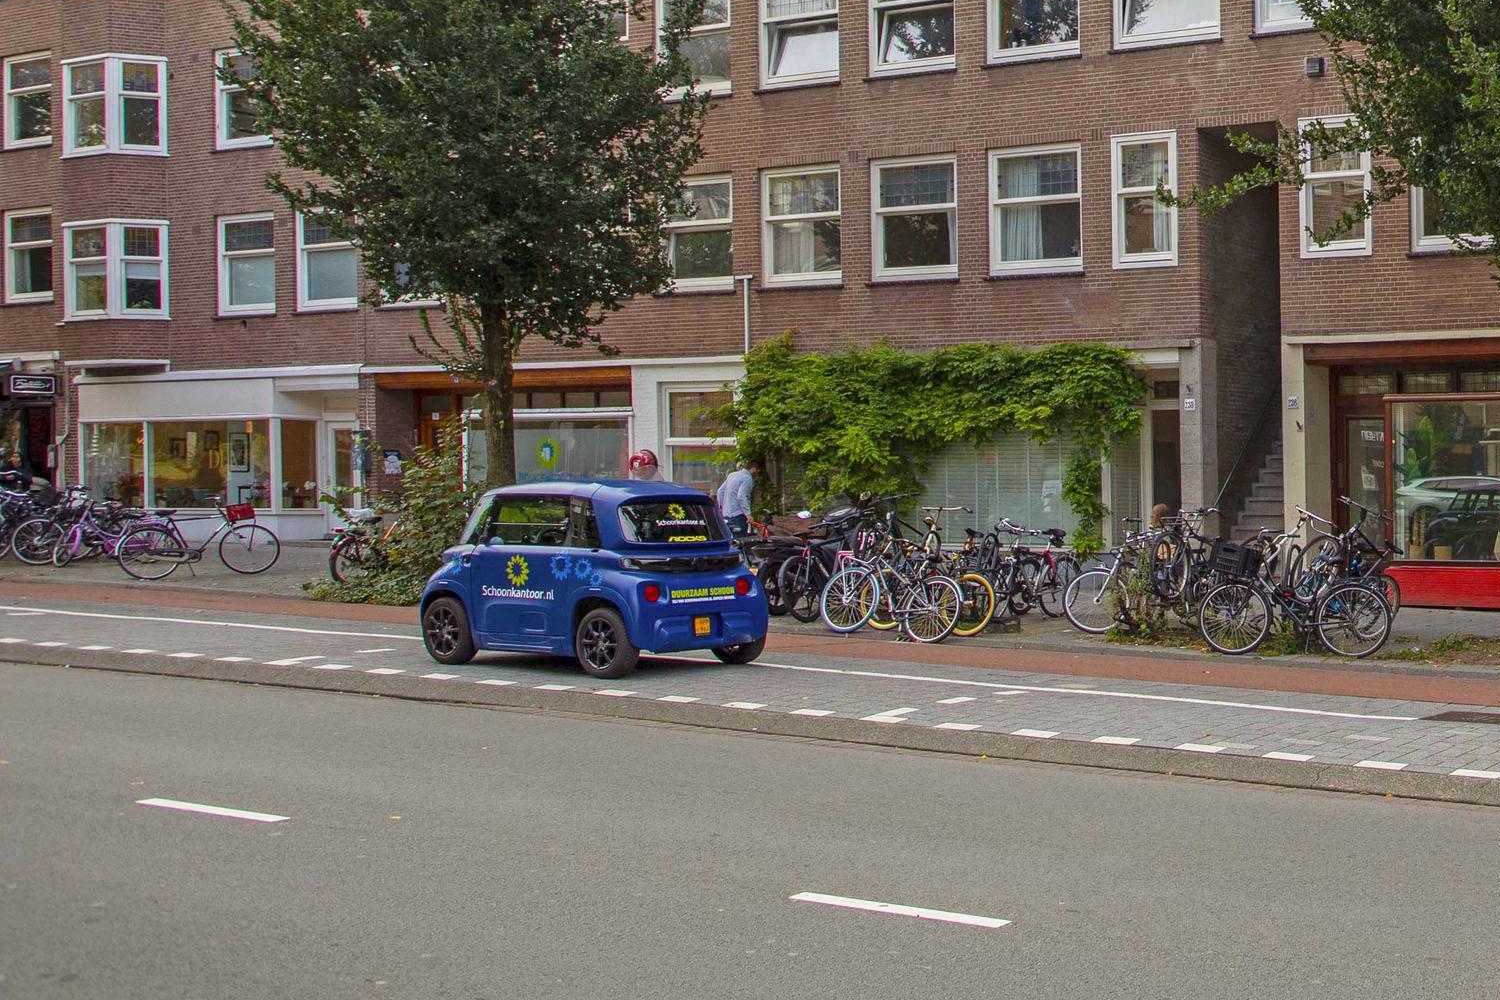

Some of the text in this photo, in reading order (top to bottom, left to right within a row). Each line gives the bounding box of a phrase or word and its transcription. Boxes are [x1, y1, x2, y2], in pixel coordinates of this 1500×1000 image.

[656, 519, 706, 527] Schoonkantoor.nl
[668, 535, 708, 543] ROCKS
[481, 584, 555, 601] Schoonkantoor.nl
[670, 585, 735, 599] DUURZAAM SCHOON
